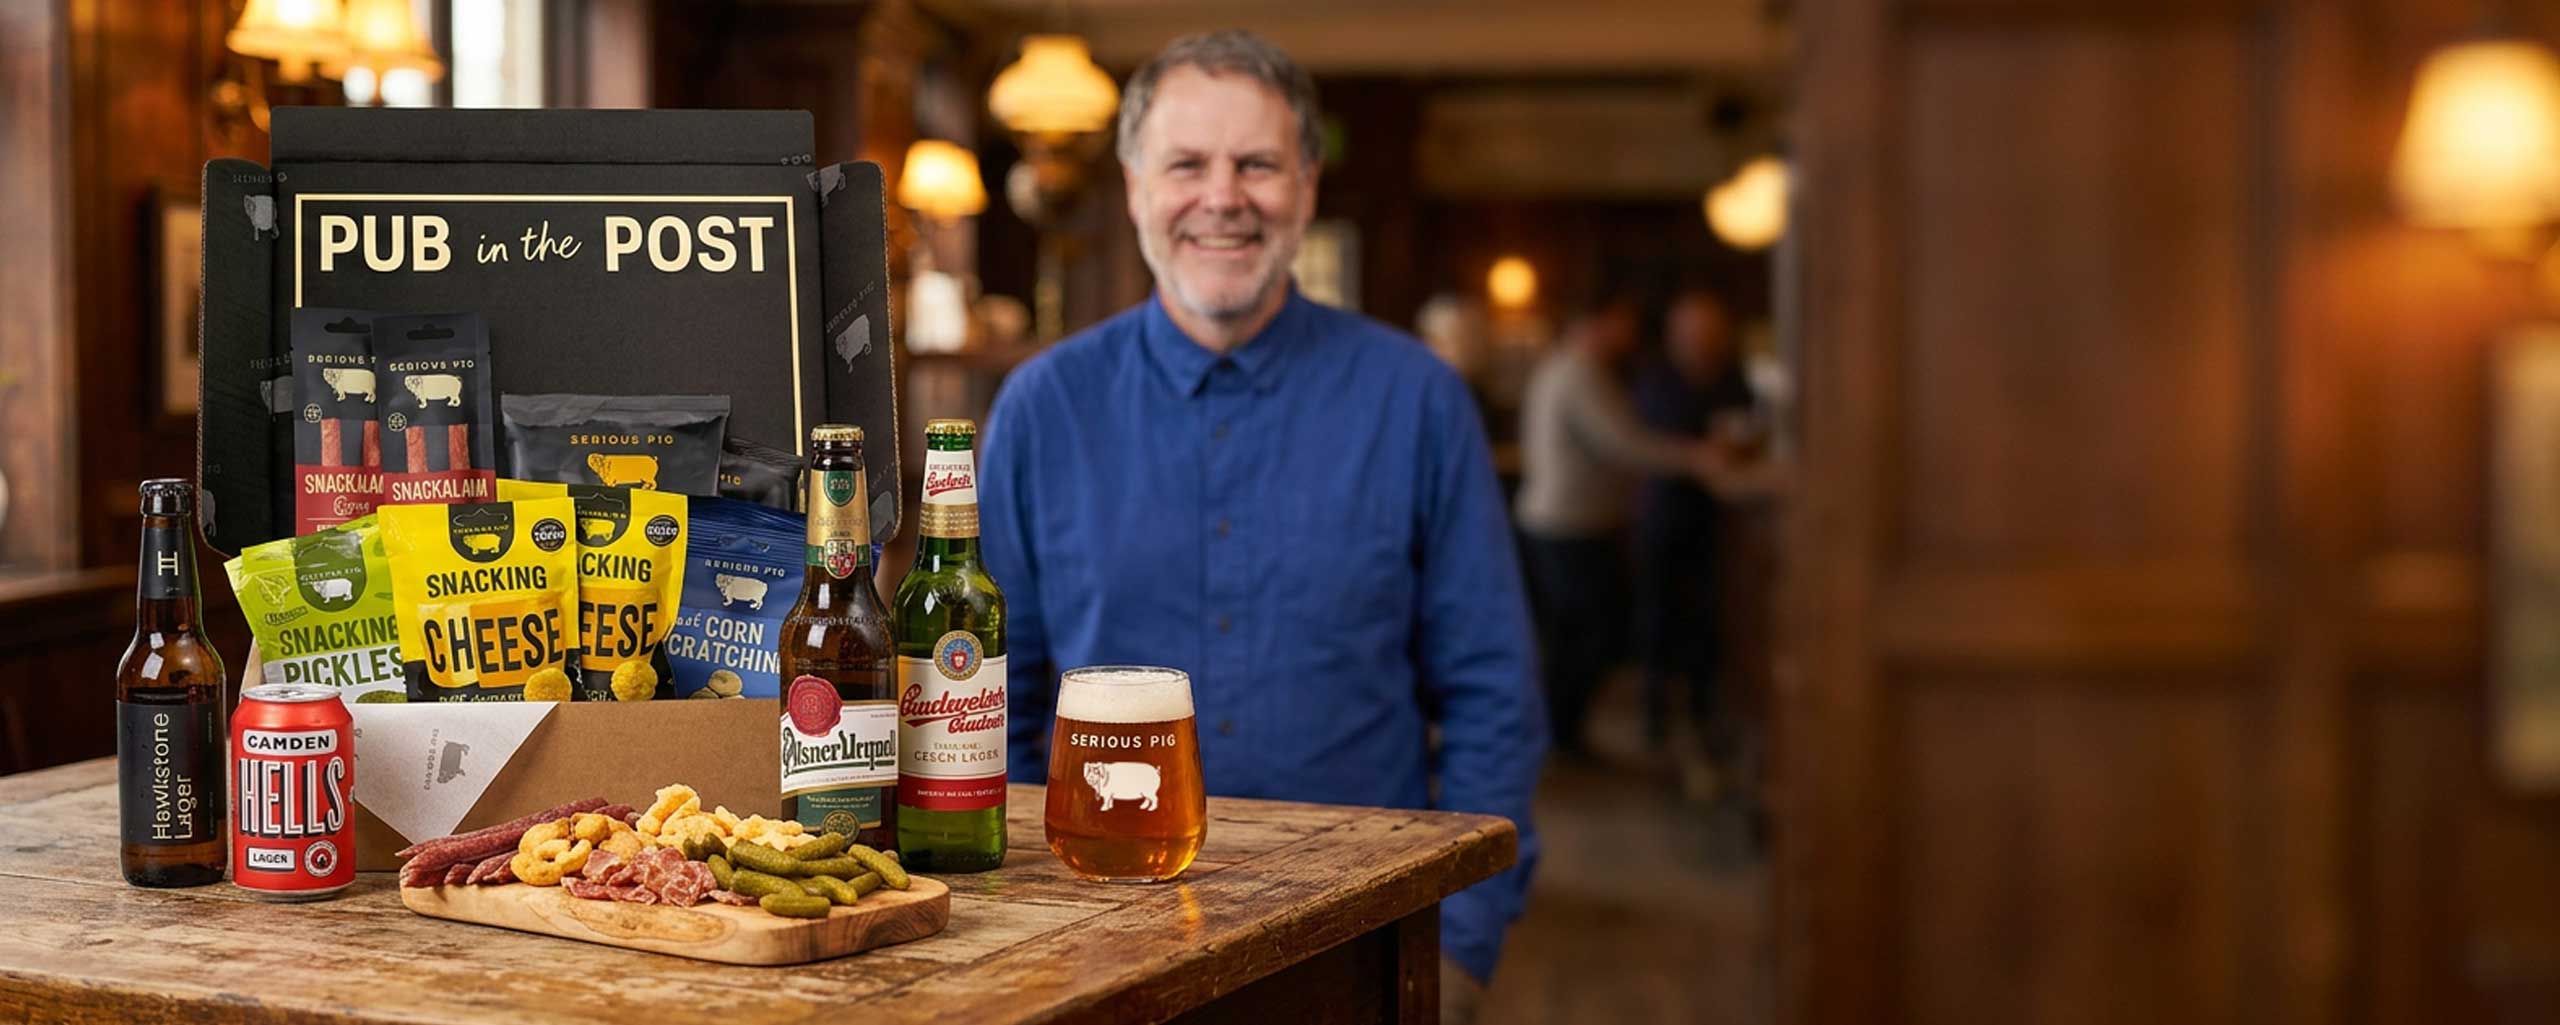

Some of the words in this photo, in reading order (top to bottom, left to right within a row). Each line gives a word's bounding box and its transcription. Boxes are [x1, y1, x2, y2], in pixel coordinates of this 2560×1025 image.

[320, 214, 451, 272] PUB
[476, 234, 509, 264] in
[520, 221, 583, 261] the
[605, 215, 775, 272] POST
[426, 565, 548, 598] SNACKING
[423, 608, 564, 673] CHEESE
[704, 615, 764, 645] CORN
[247, 735, 331, 750] CAMDEN
[1070, 733, 1143, 748] SERIOUS
[1150, 733, 1177, 748] PIG
[152, 712, 172, 840] Hawkstone
[238, 755, 346, 841] HELLS
